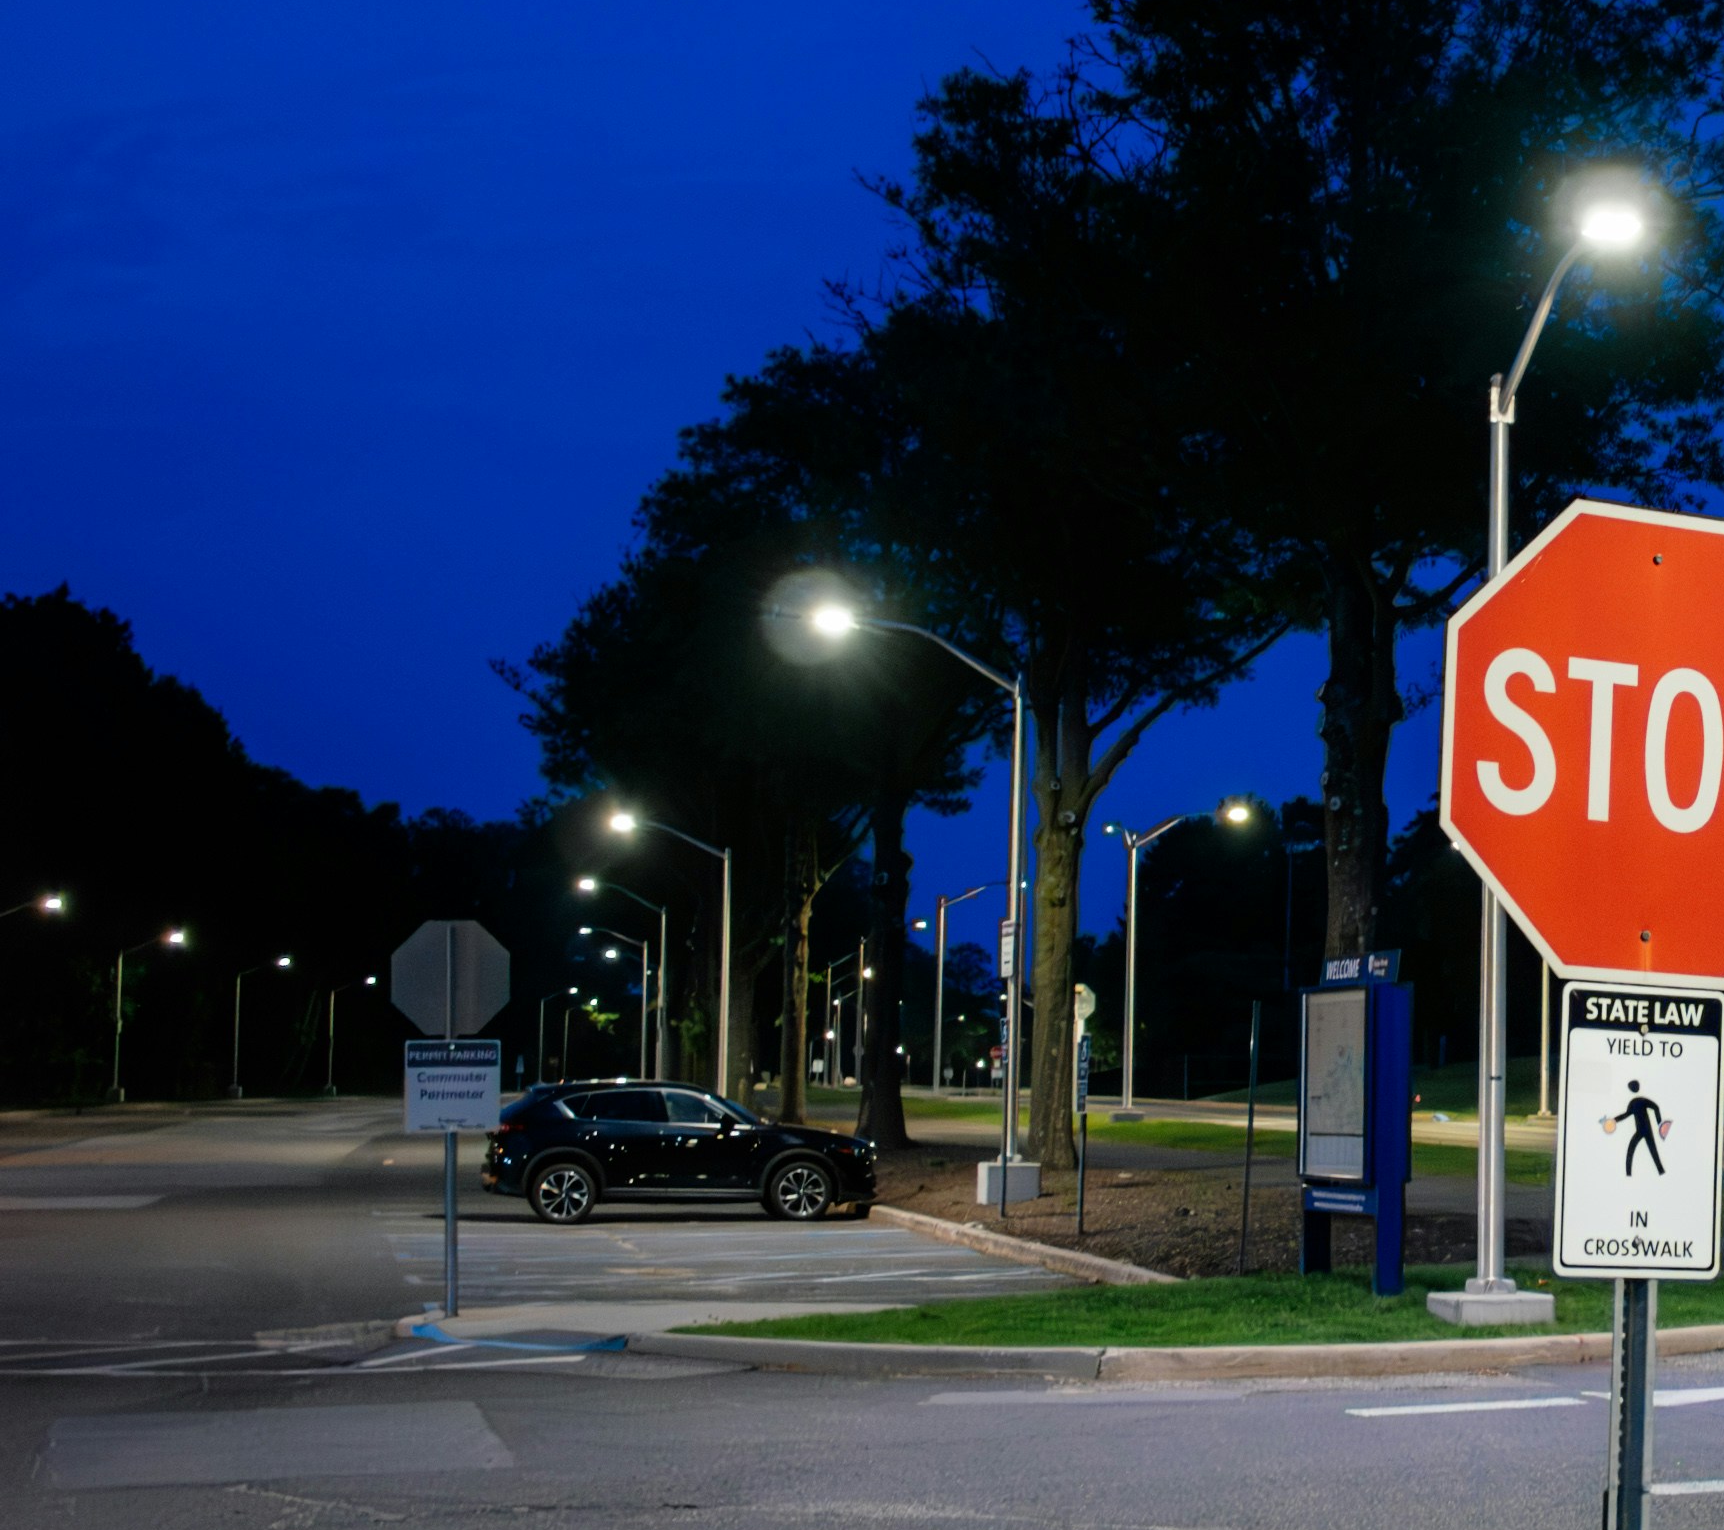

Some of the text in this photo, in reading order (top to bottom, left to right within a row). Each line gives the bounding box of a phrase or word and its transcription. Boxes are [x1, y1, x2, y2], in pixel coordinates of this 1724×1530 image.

[1326, 958, 1360, 980] WELCOME
[1586, 997, 1704, 1026] STATE LAW
[450, 1049, 497, 1061] PARKING
[1607, 1038, 1683, 1058] YIELD TO
[417, 1071, 487, 1083] Commuter
[1630, 1211, 1648, 1228] IN
[1584, 1238, 1693, 1258] CROSSWALK
